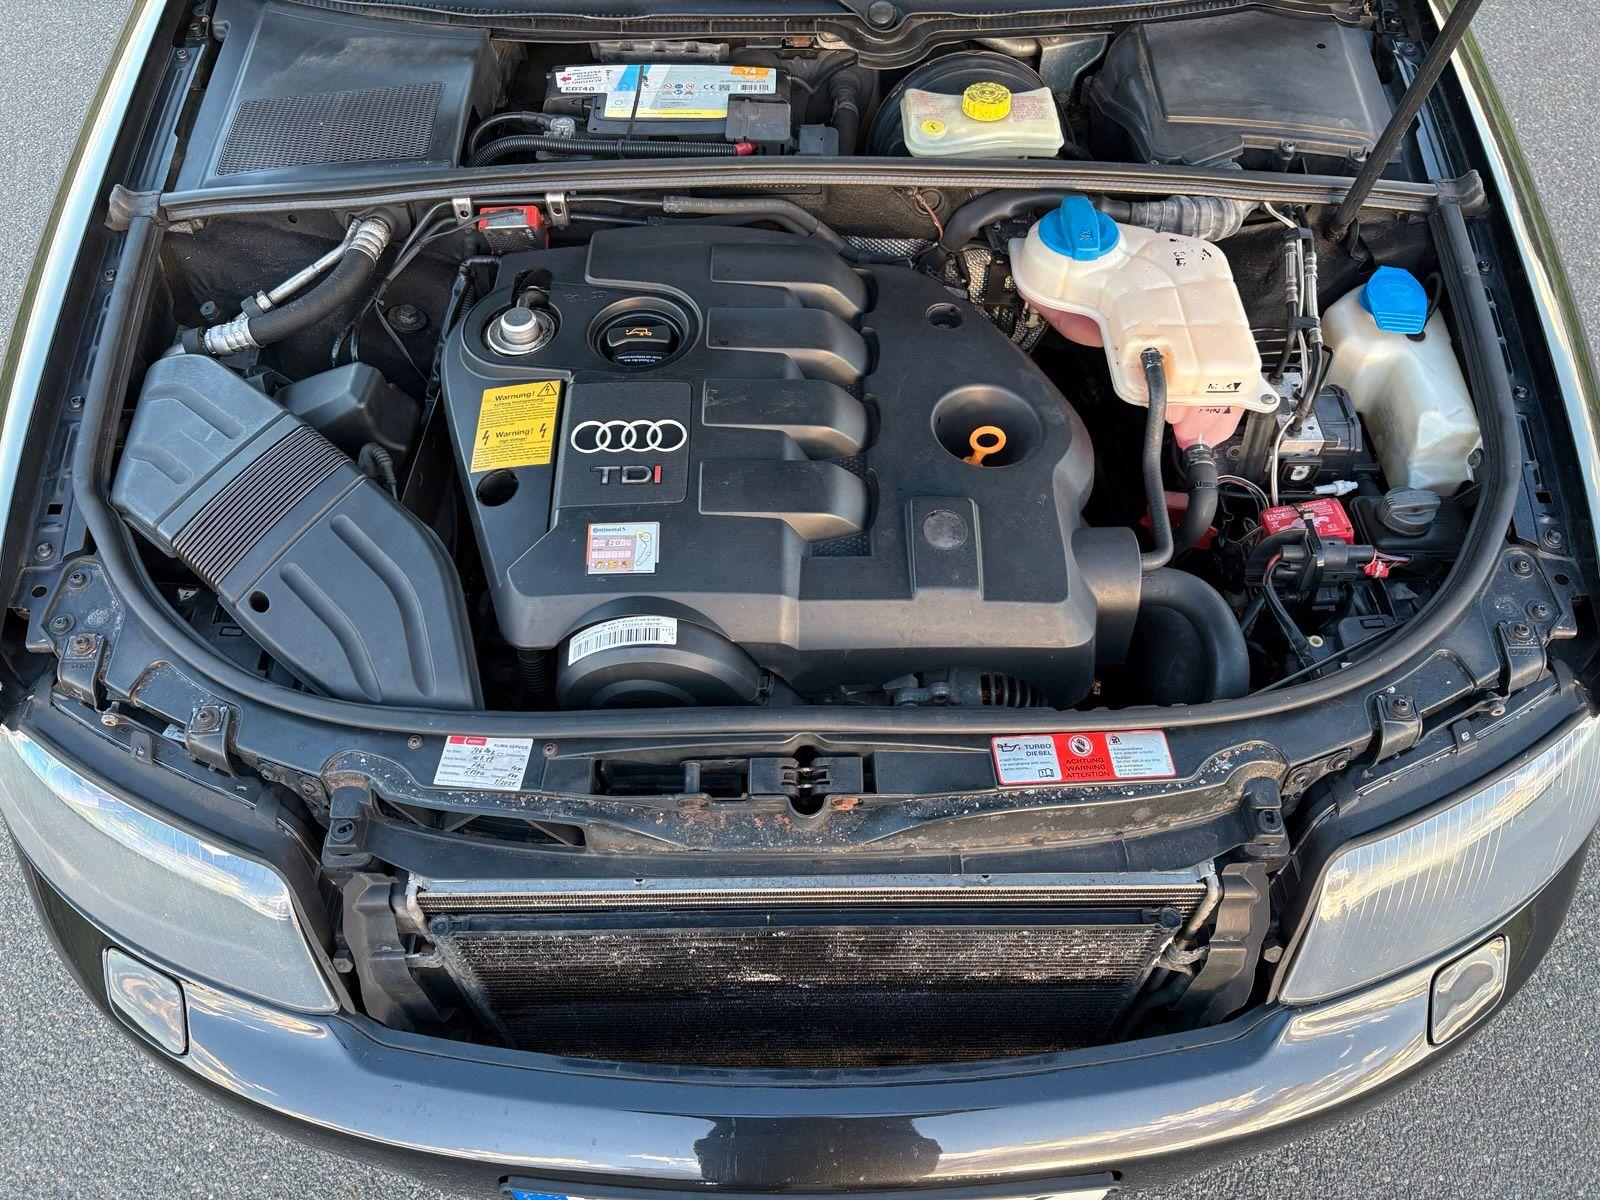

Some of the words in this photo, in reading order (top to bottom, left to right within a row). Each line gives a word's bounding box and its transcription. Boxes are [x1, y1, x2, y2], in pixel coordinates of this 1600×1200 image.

[495, 391, 535, 401] Warnung!
[496, 428, 534, 438] Warning!
[590, 465, 662, 484] TDI
[1066, 757, 1105, 765] ACHTUNG
[1066, 764, 1106, 772] WARNING
[1066, 771, 1110, 779] ATTENTION
